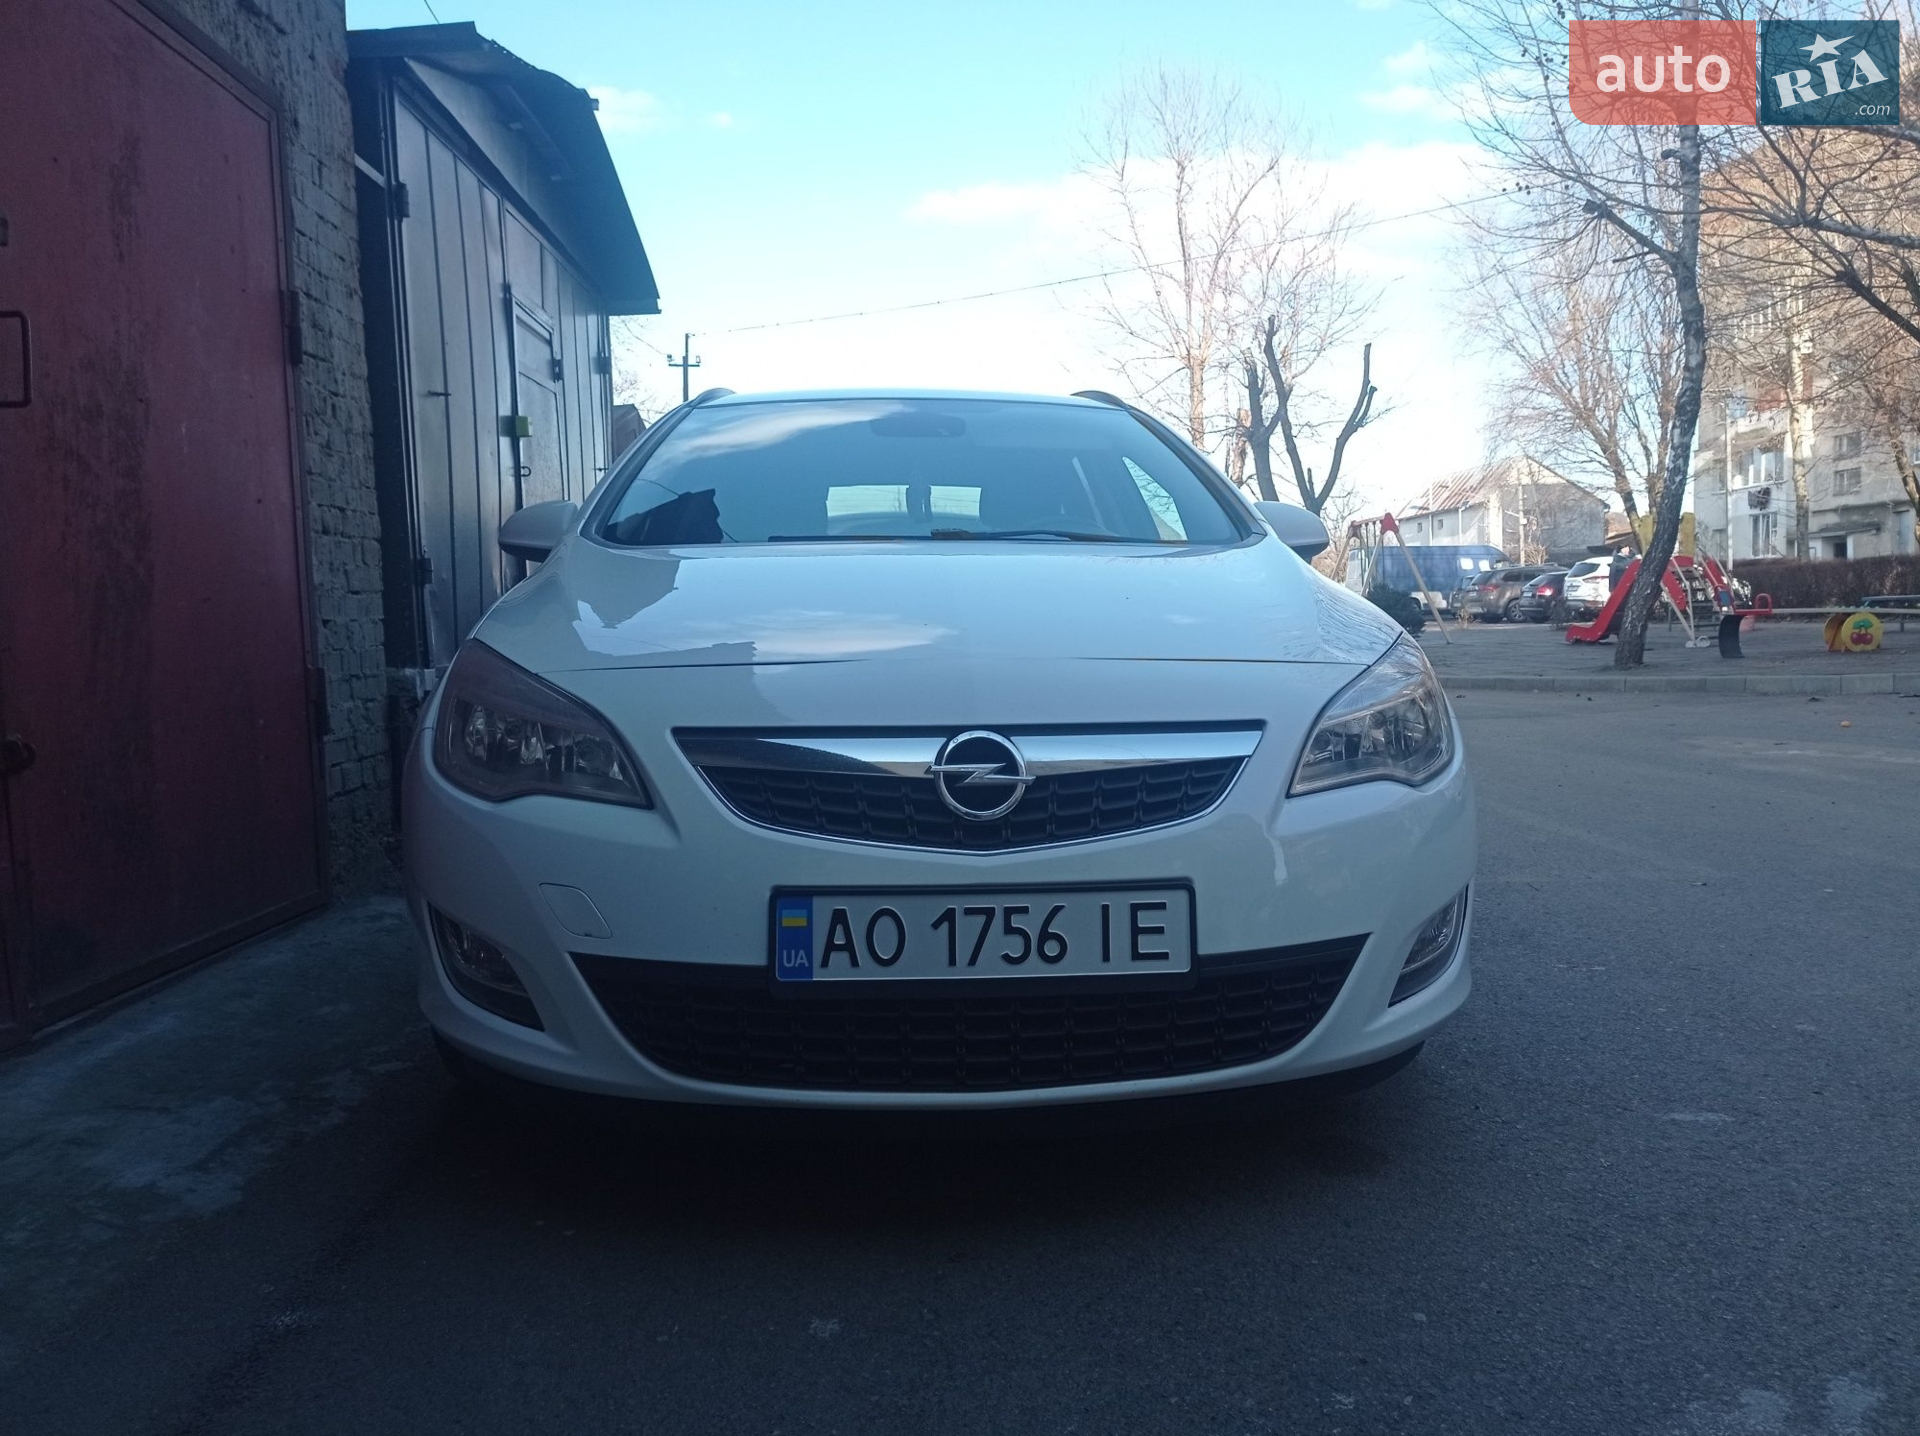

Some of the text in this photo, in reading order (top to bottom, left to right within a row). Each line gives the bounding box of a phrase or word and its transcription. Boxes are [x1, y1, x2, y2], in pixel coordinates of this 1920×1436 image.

[820, 901, 1171, 968] AO 1756 IE
[782, 949, 809, 968] UA
